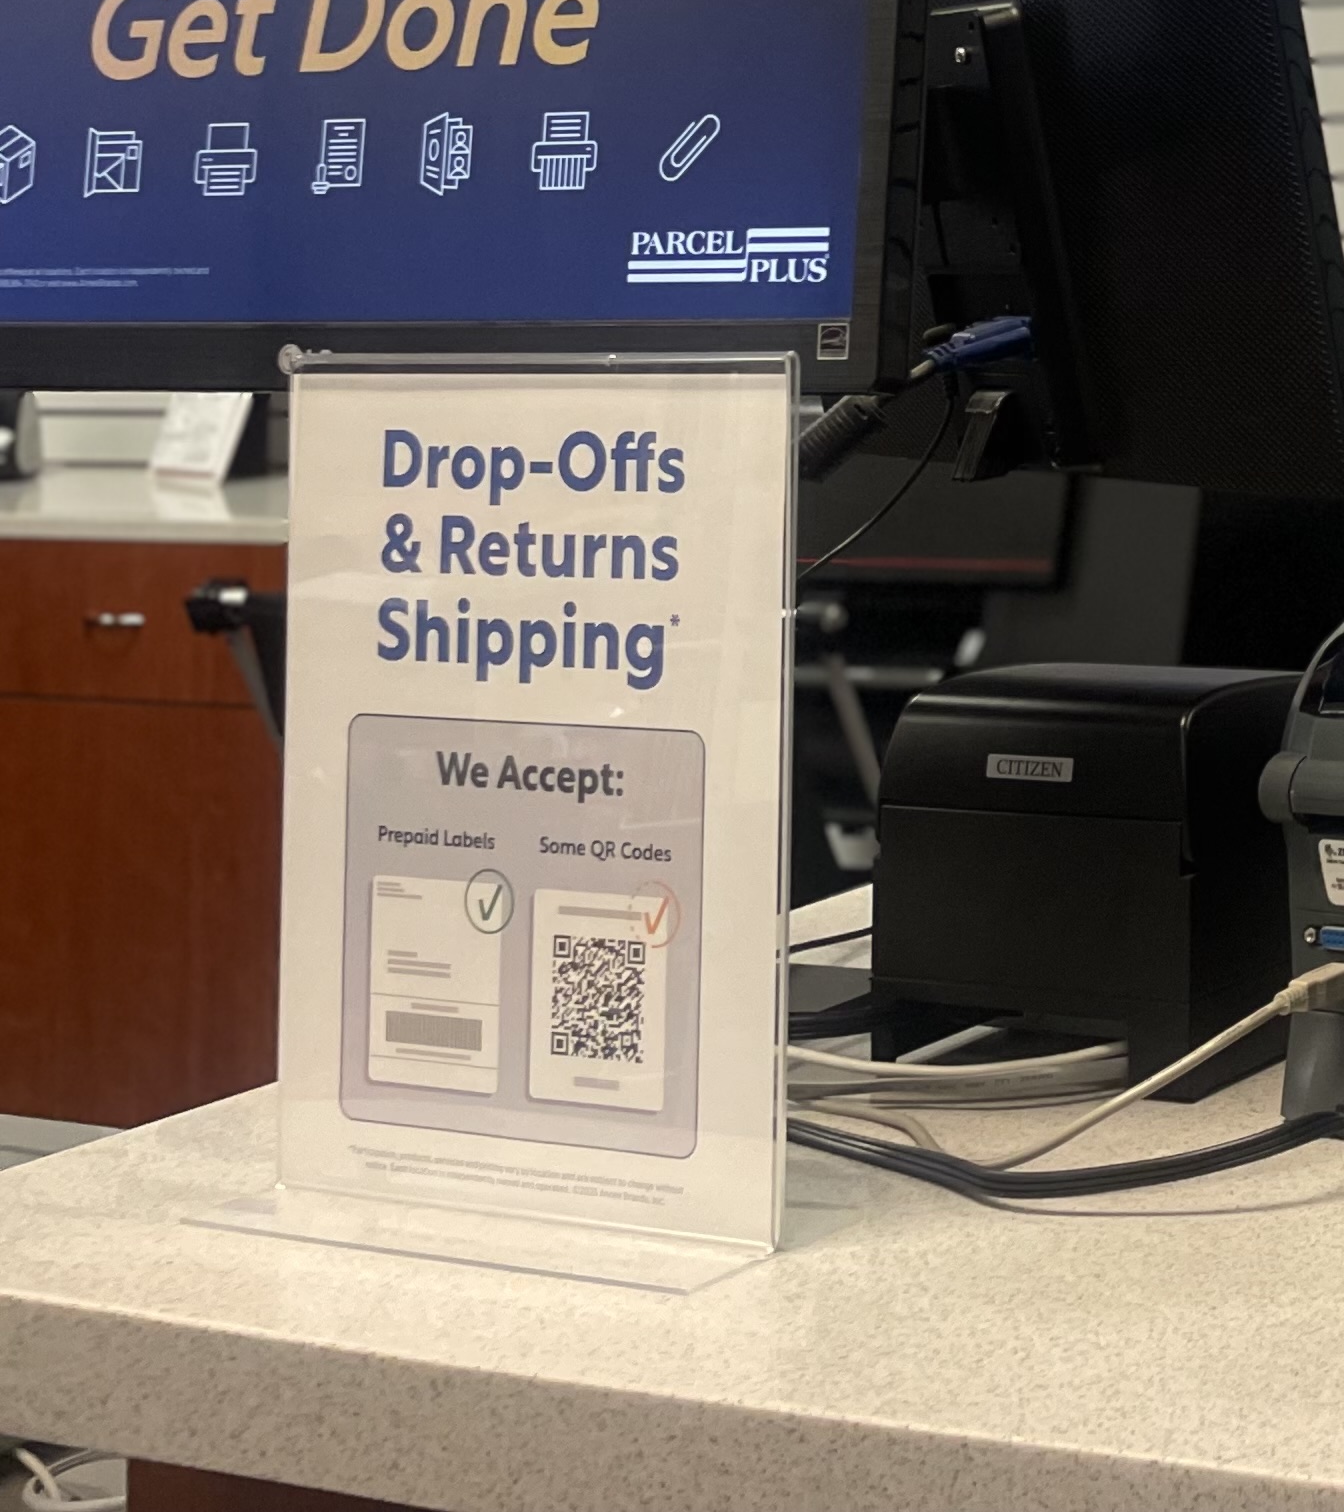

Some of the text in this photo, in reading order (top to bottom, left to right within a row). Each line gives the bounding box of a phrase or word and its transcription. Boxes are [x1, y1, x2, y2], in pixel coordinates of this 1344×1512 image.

[631, 230, 744, 255] PARCEL
[750, 258, 828, 283] PLUS
[382, 429, 686, 506] Drop-Offs
[381, 513, 680, 581] & Returns
[437, 751, 625, 803] We Accept:
[996, 759, 1063, 778] CITIZEN
[378, 825, 496, 850] Prepaid Labels
[539, 836, 673, 863] Some QR Codes
